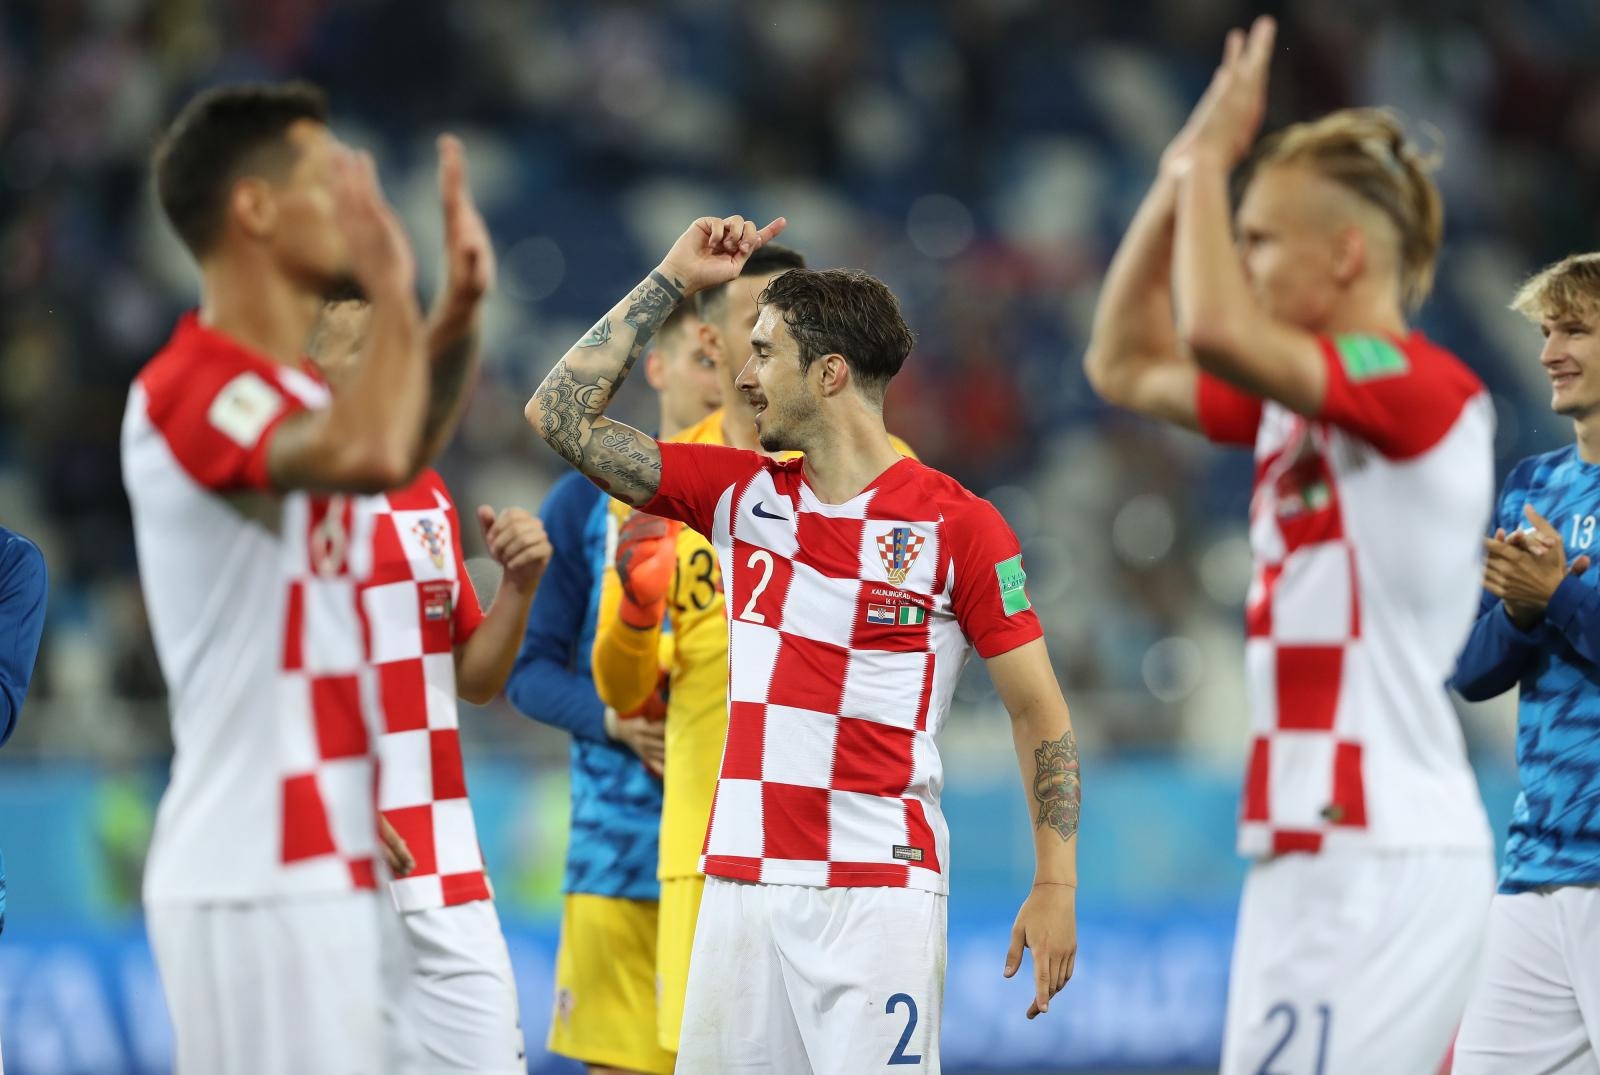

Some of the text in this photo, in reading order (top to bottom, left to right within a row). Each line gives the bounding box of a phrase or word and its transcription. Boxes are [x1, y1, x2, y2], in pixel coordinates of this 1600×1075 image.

[1570, 513, 1596, 549] 13
[739, 549, 774, 624] 2
[885, 992, 922, 1066] 2
[1254, 1001, 1331, 1075] 21
